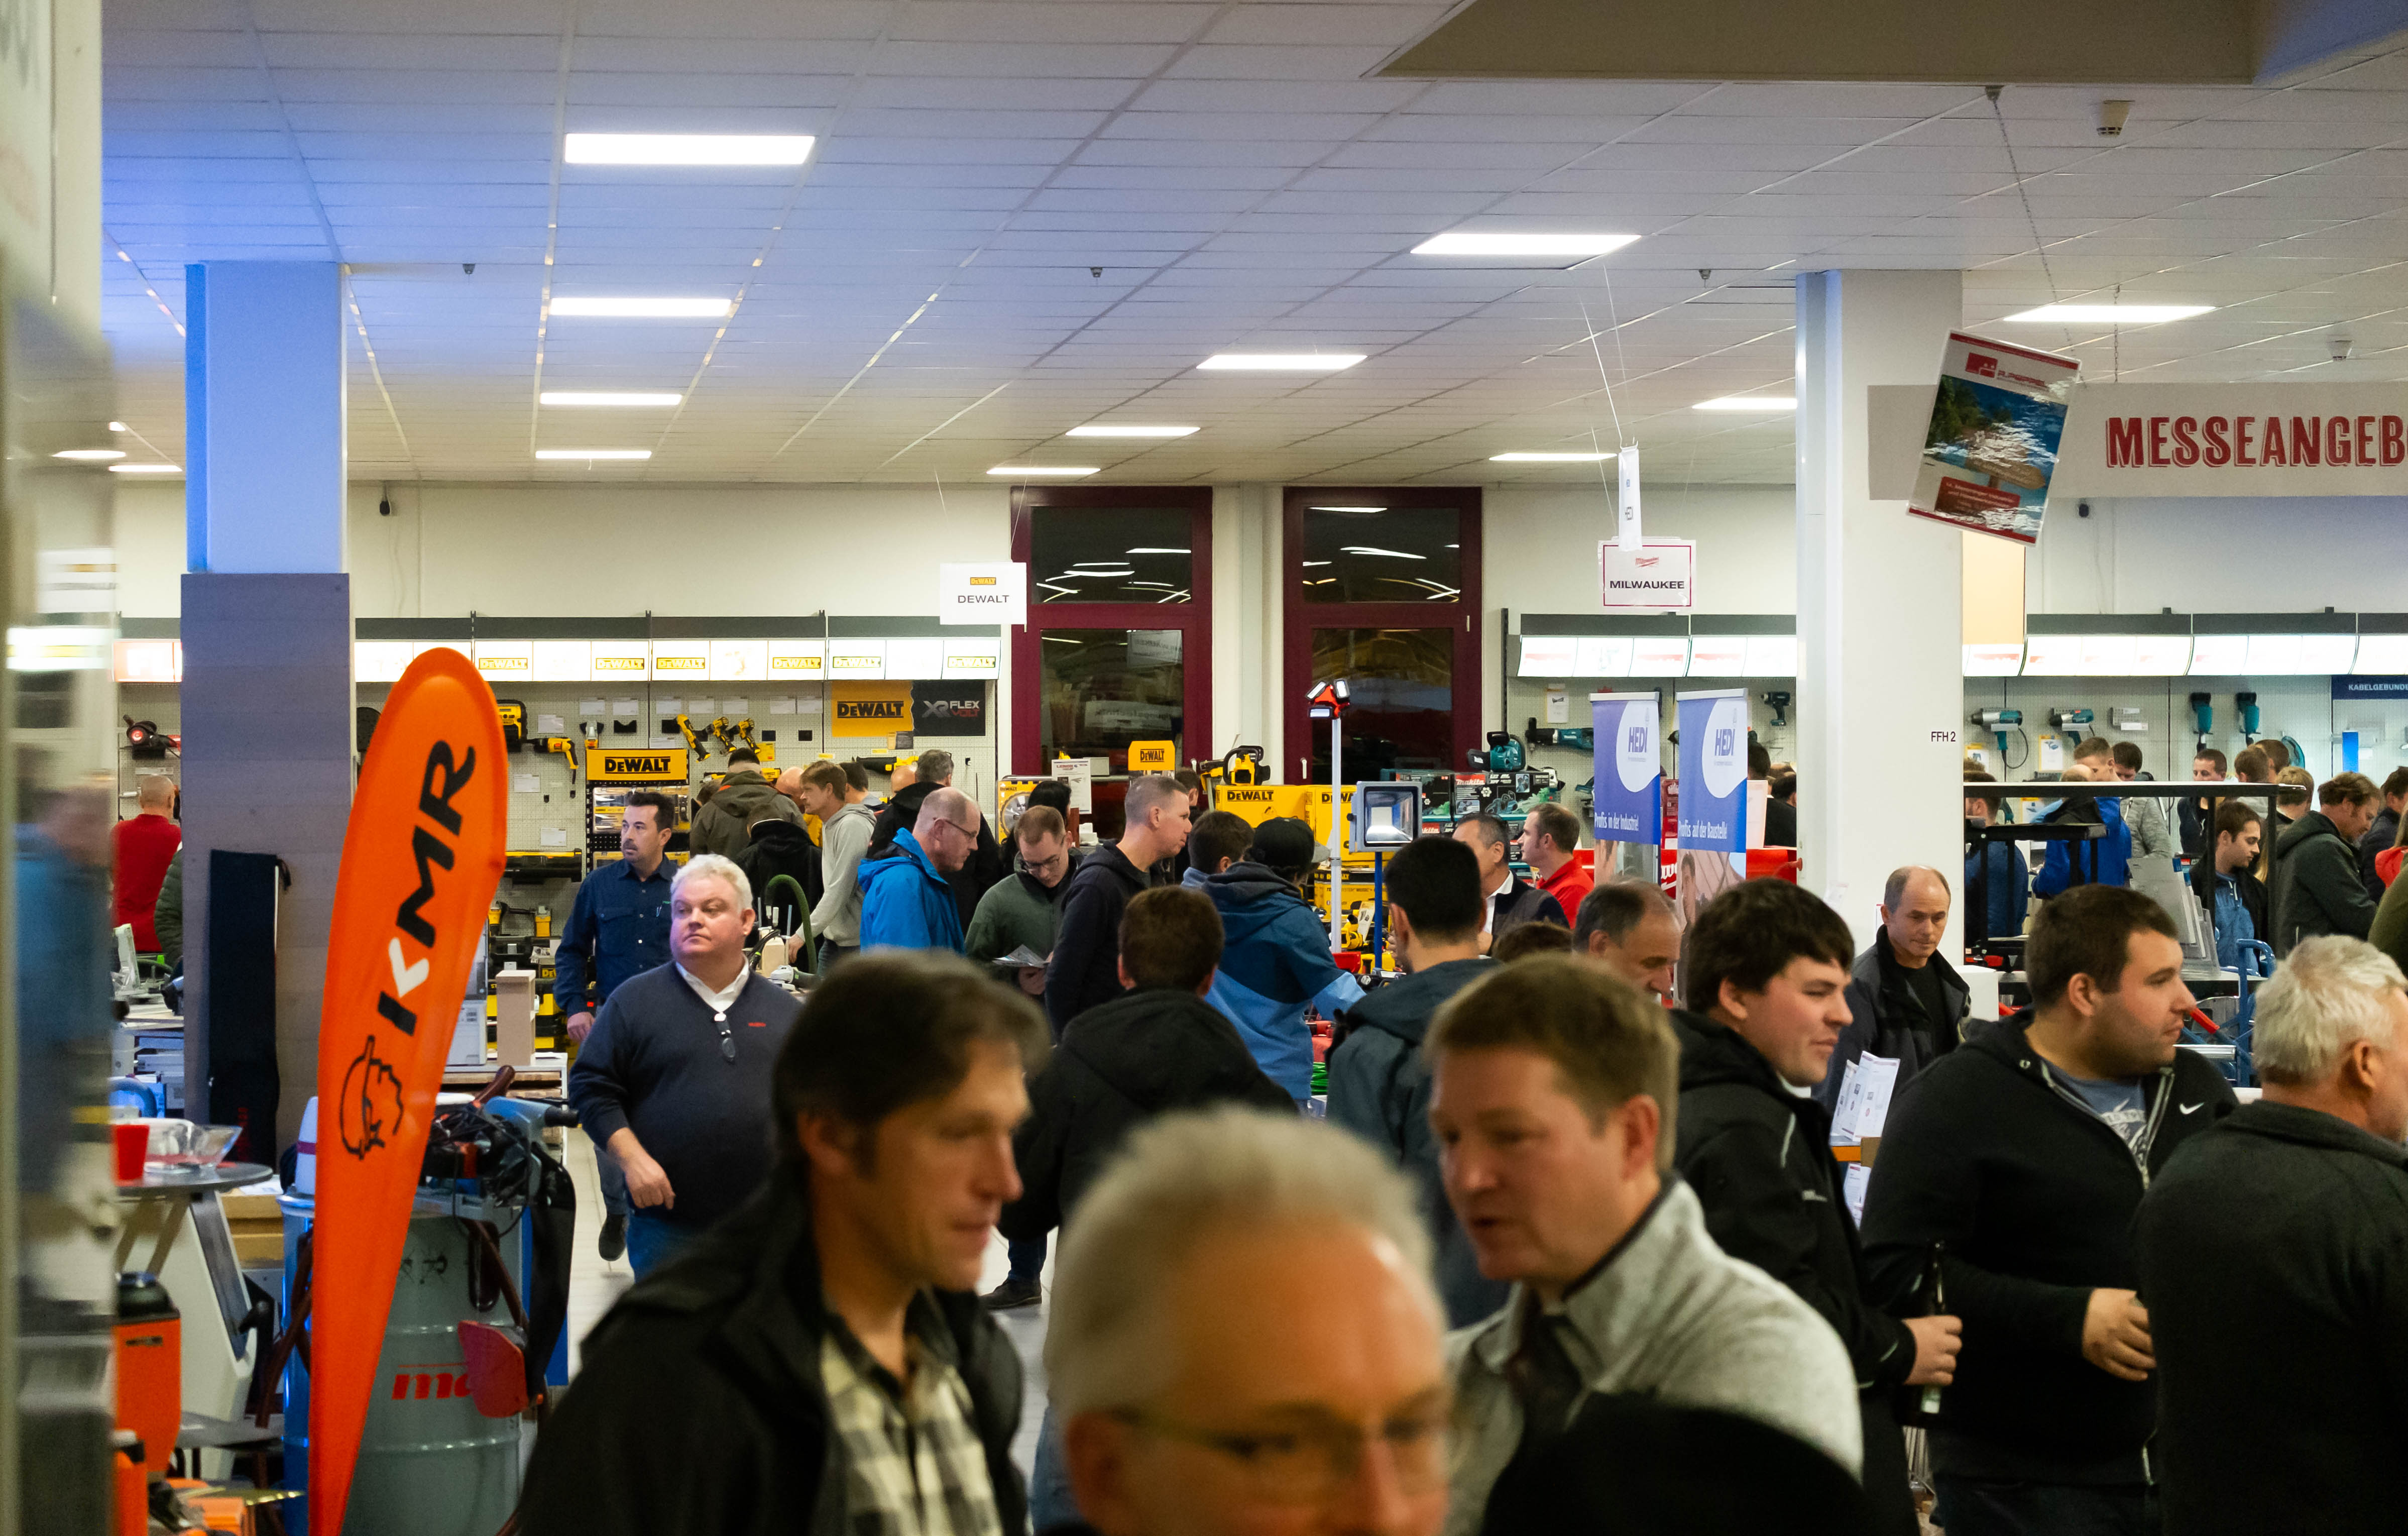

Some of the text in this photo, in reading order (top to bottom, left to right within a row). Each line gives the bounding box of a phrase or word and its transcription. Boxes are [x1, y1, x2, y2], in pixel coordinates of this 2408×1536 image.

[2106, 415, 2408, 468] MESSEANGEB
[1610, 581, 1685, 589] MILWAUKEE
[958, 595, 1009, 603] DEWALT
[950, 701, 980, 709] FLEX
[1628, 727, 1648, 752] HEDI
[1714, 728, 1735, 755] HEDI
[1931, 731, 1956, 742] FFH 2
[1140, 750, 1165, 761] DEWALT
[605, 758, 671, 773] DEWALT
[1227, 791, 1274, 801] DEWALT
[378, 740, 476, 1037] KMR
